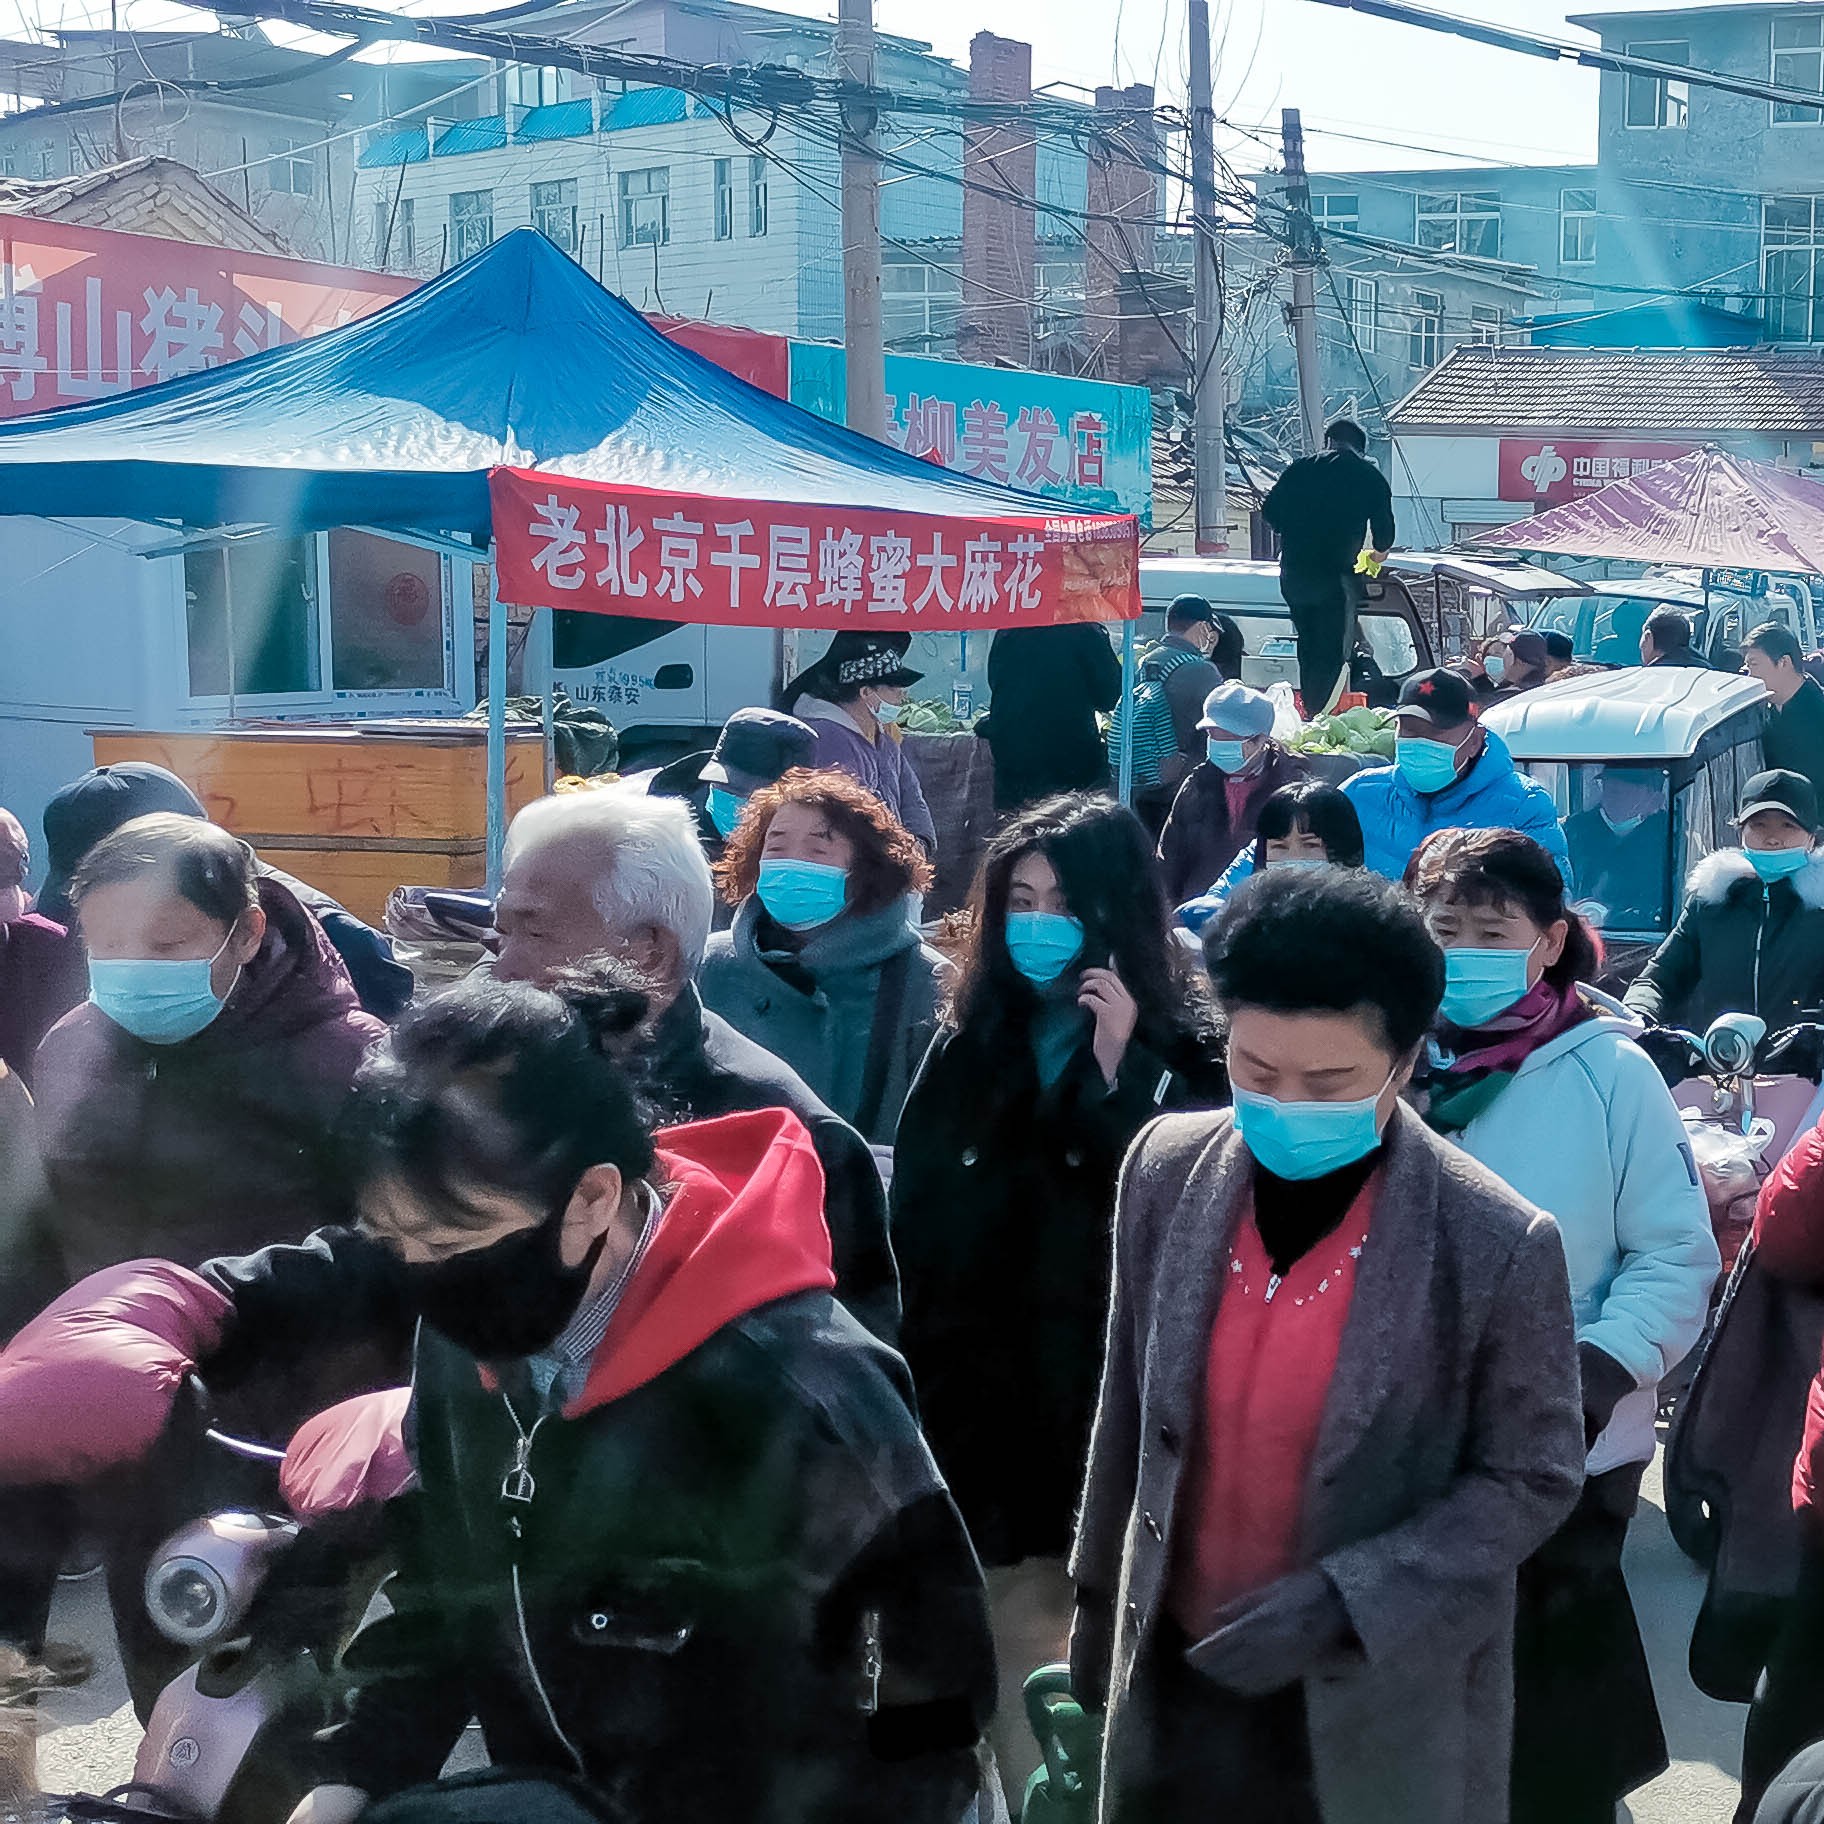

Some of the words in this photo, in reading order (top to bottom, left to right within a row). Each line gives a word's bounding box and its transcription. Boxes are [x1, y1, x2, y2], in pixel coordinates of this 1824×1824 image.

[528, 493, 1045, 614] 老北京千层蜂蜜大麻花
[575, 683, 640, 705] 山东泰安
